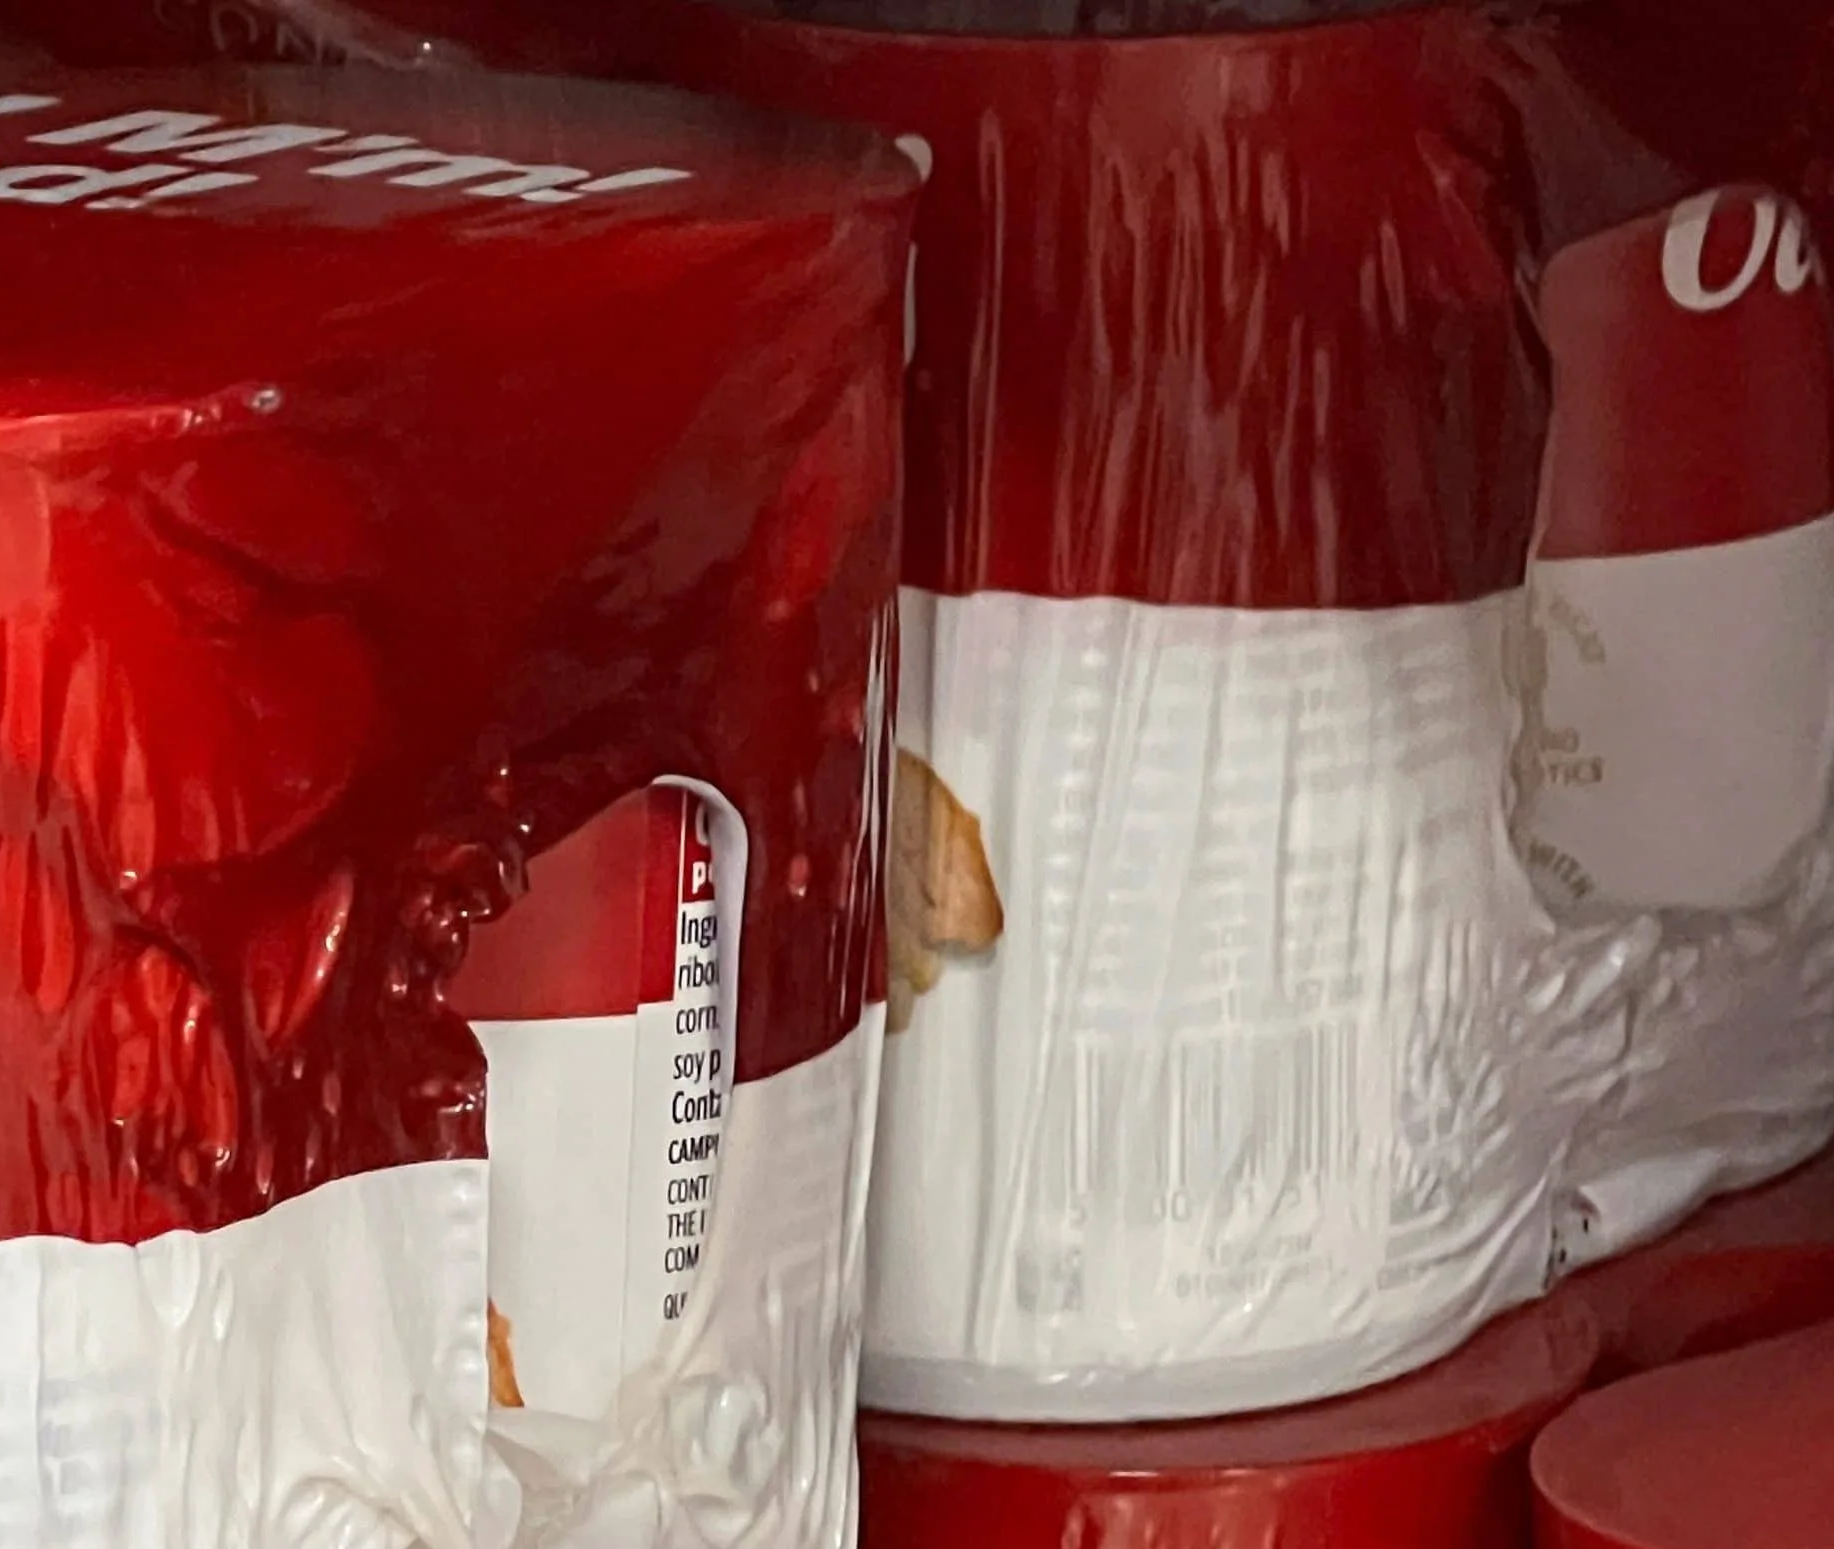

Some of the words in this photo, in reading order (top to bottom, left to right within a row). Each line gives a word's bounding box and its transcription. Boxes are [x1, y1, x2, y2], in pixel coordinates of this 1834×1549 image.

[27, 110, 693, 202] M'm!
[673, 1052, 705, 1083] soy
[667, 1208, 697, 1239] THE
